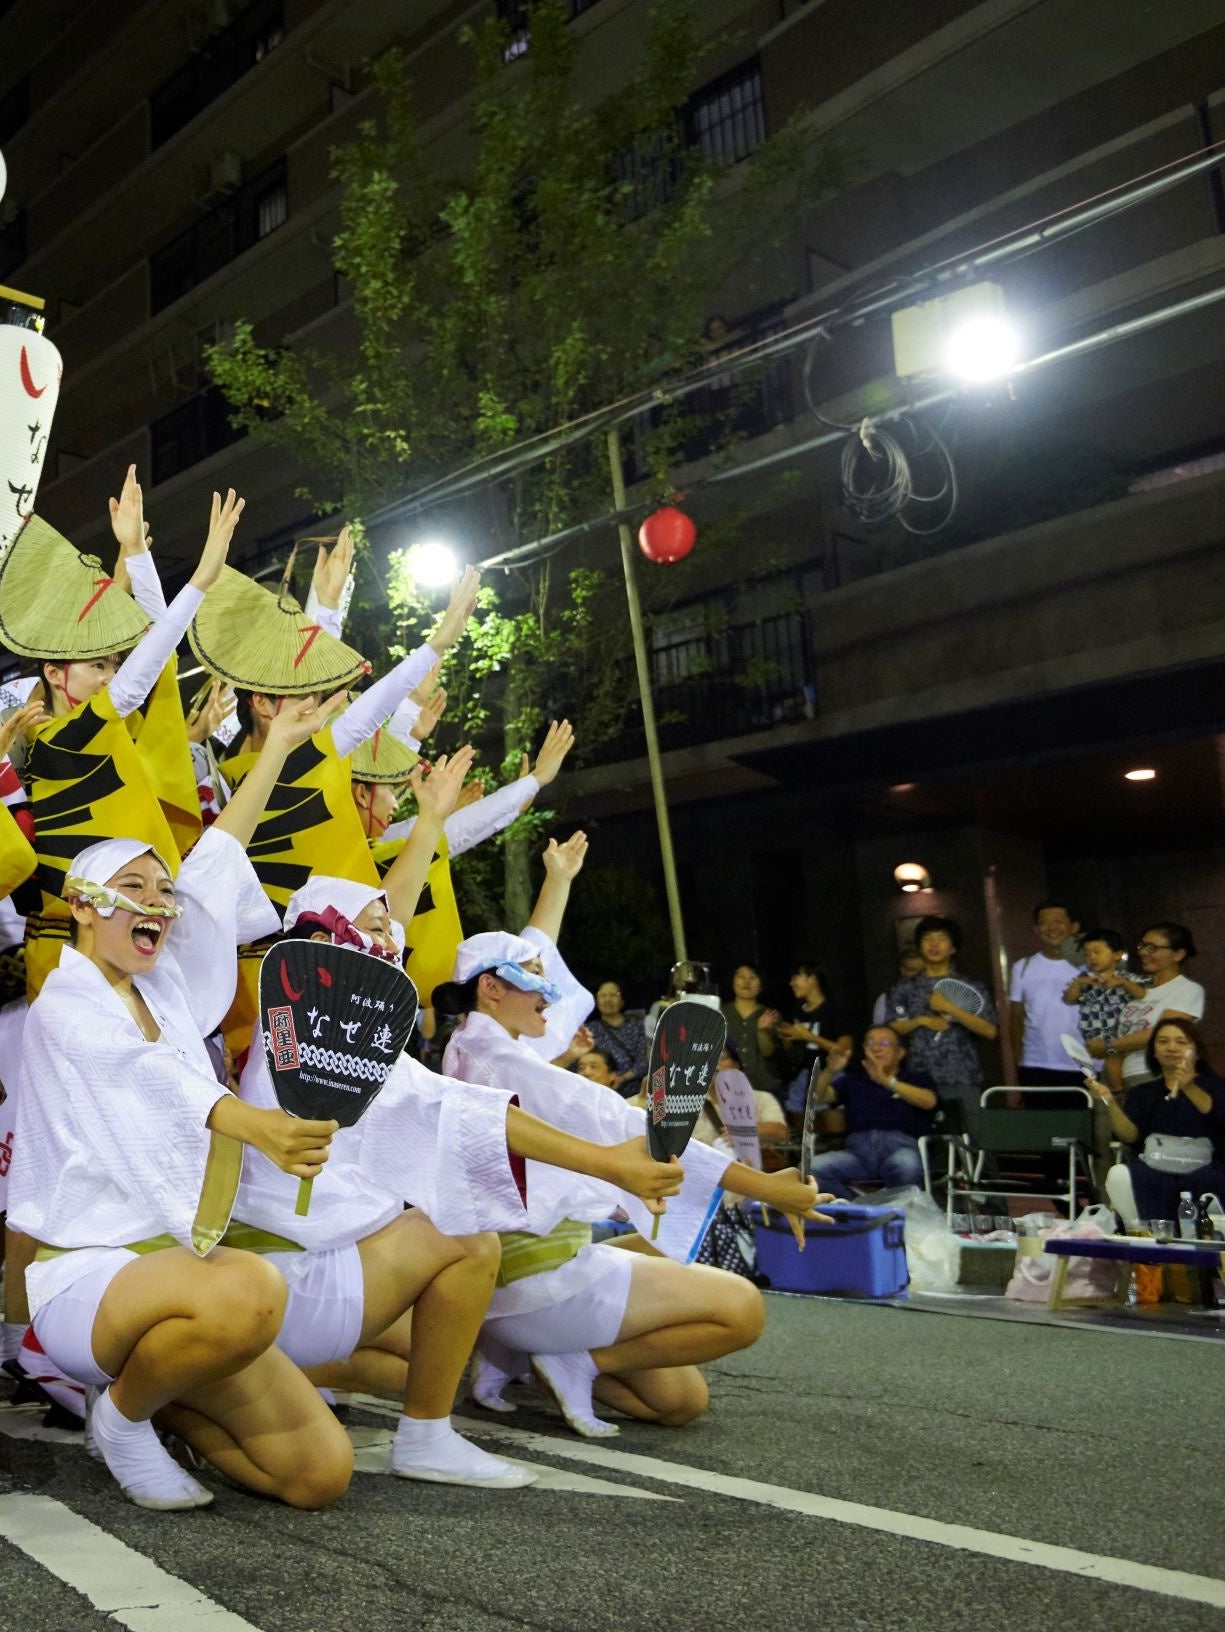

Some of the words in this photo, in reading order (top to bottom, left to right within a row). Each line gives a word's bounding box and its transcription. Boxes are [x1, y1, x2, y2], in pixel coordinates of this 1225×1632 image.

[350, 993, 394, 1013] 阿波踊り
[272, 1011, 296, 1067] 麻里亜
